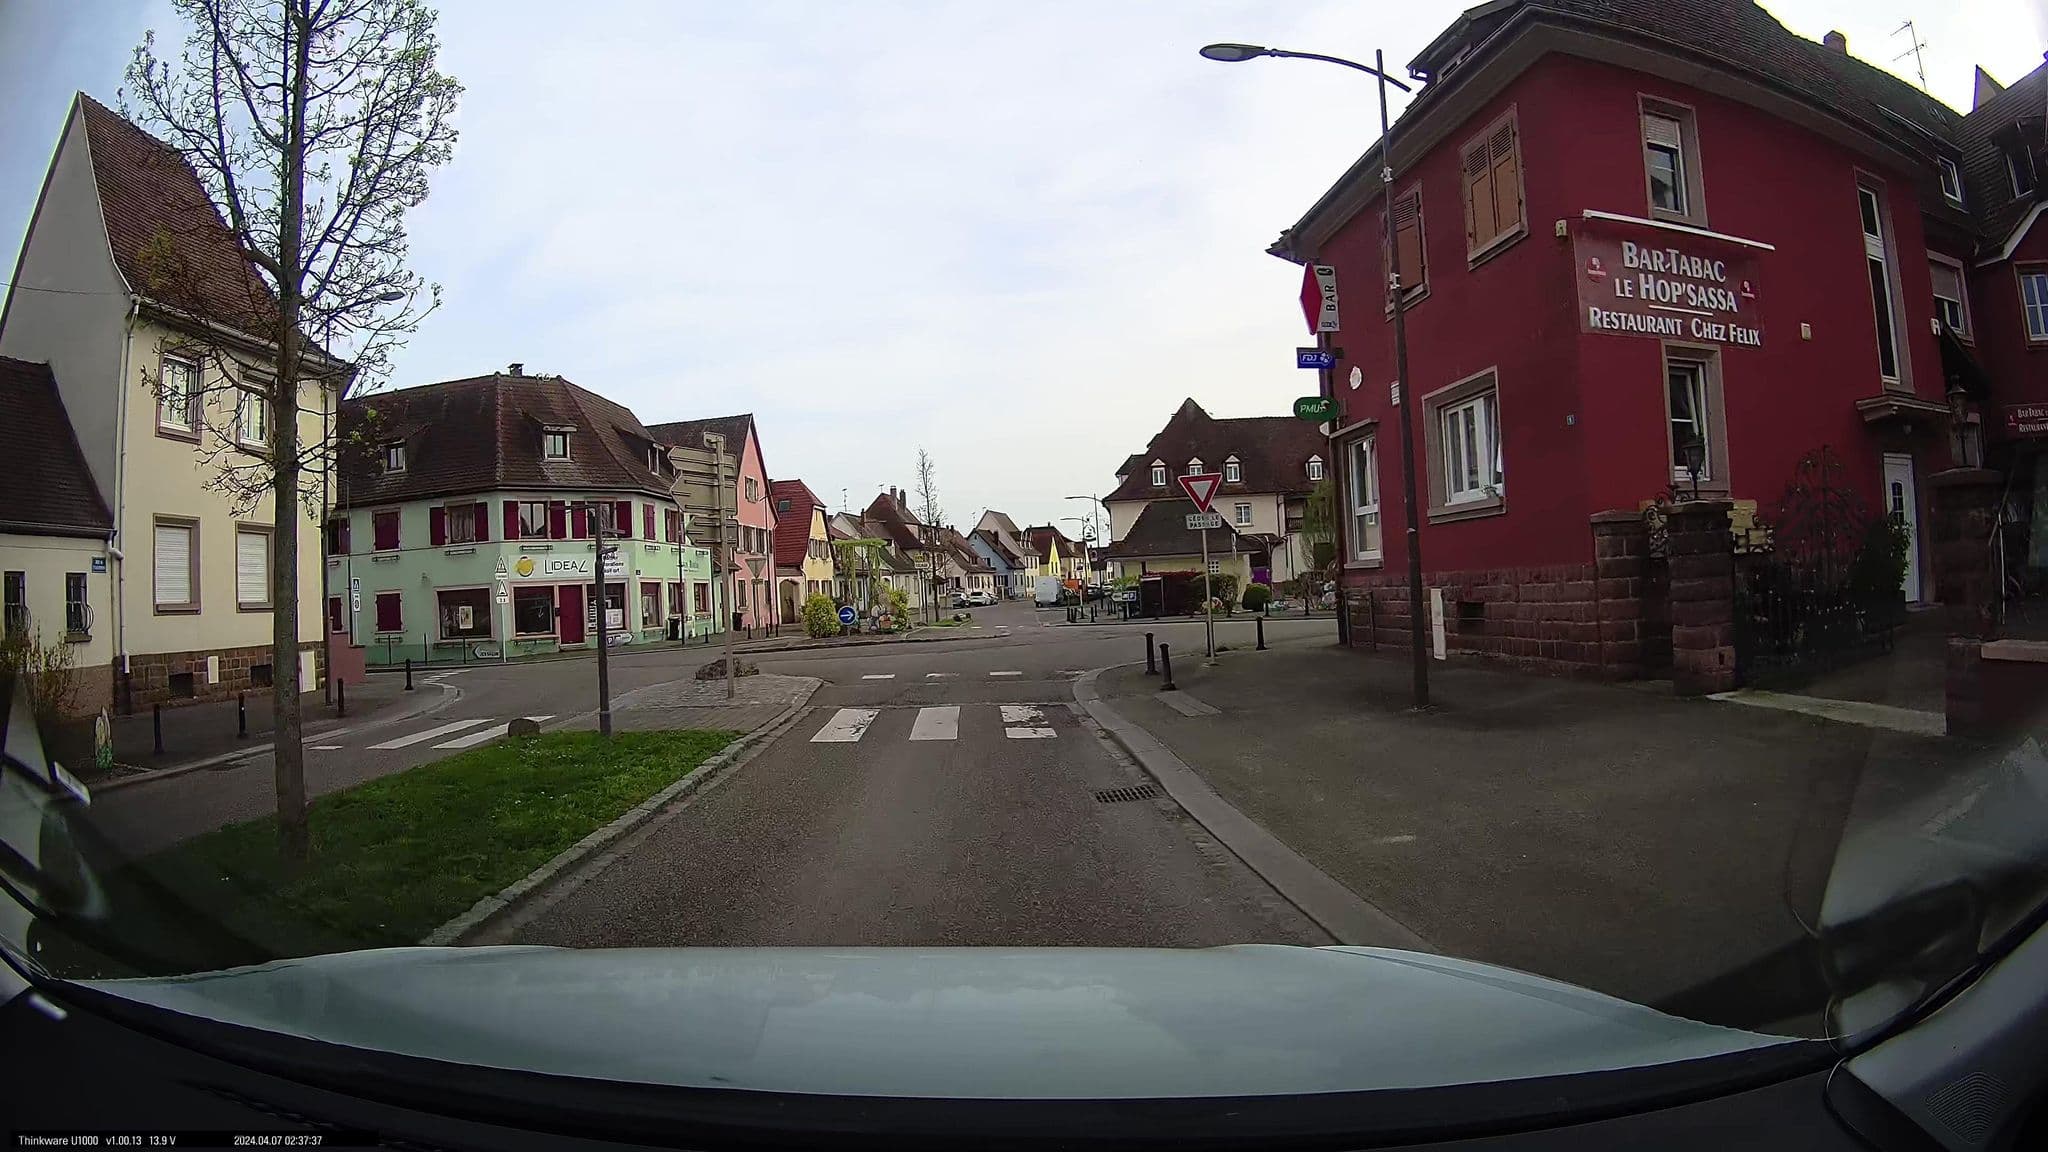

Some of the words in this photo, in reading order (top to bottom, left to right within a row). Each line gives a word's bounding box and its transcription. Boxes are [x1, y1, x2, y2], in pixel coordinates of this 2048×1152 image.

[1622, 241, 1726, 283] BAR-TABAC
[1324, 284, 1336, 312] BAR
[1615, 278, 1633, 298] LE
[1639, 273, 1738, 312] HOP'SASSA
[1589, 306, 1682, 336] RESTAURANT
[1691, 317, 1726, 341] CHEZ
[1729, 323, 1761, 346] FELIX
[1302, 354, 1317, 362] FDJ
[1300, 404, 1320, 413] PMU
